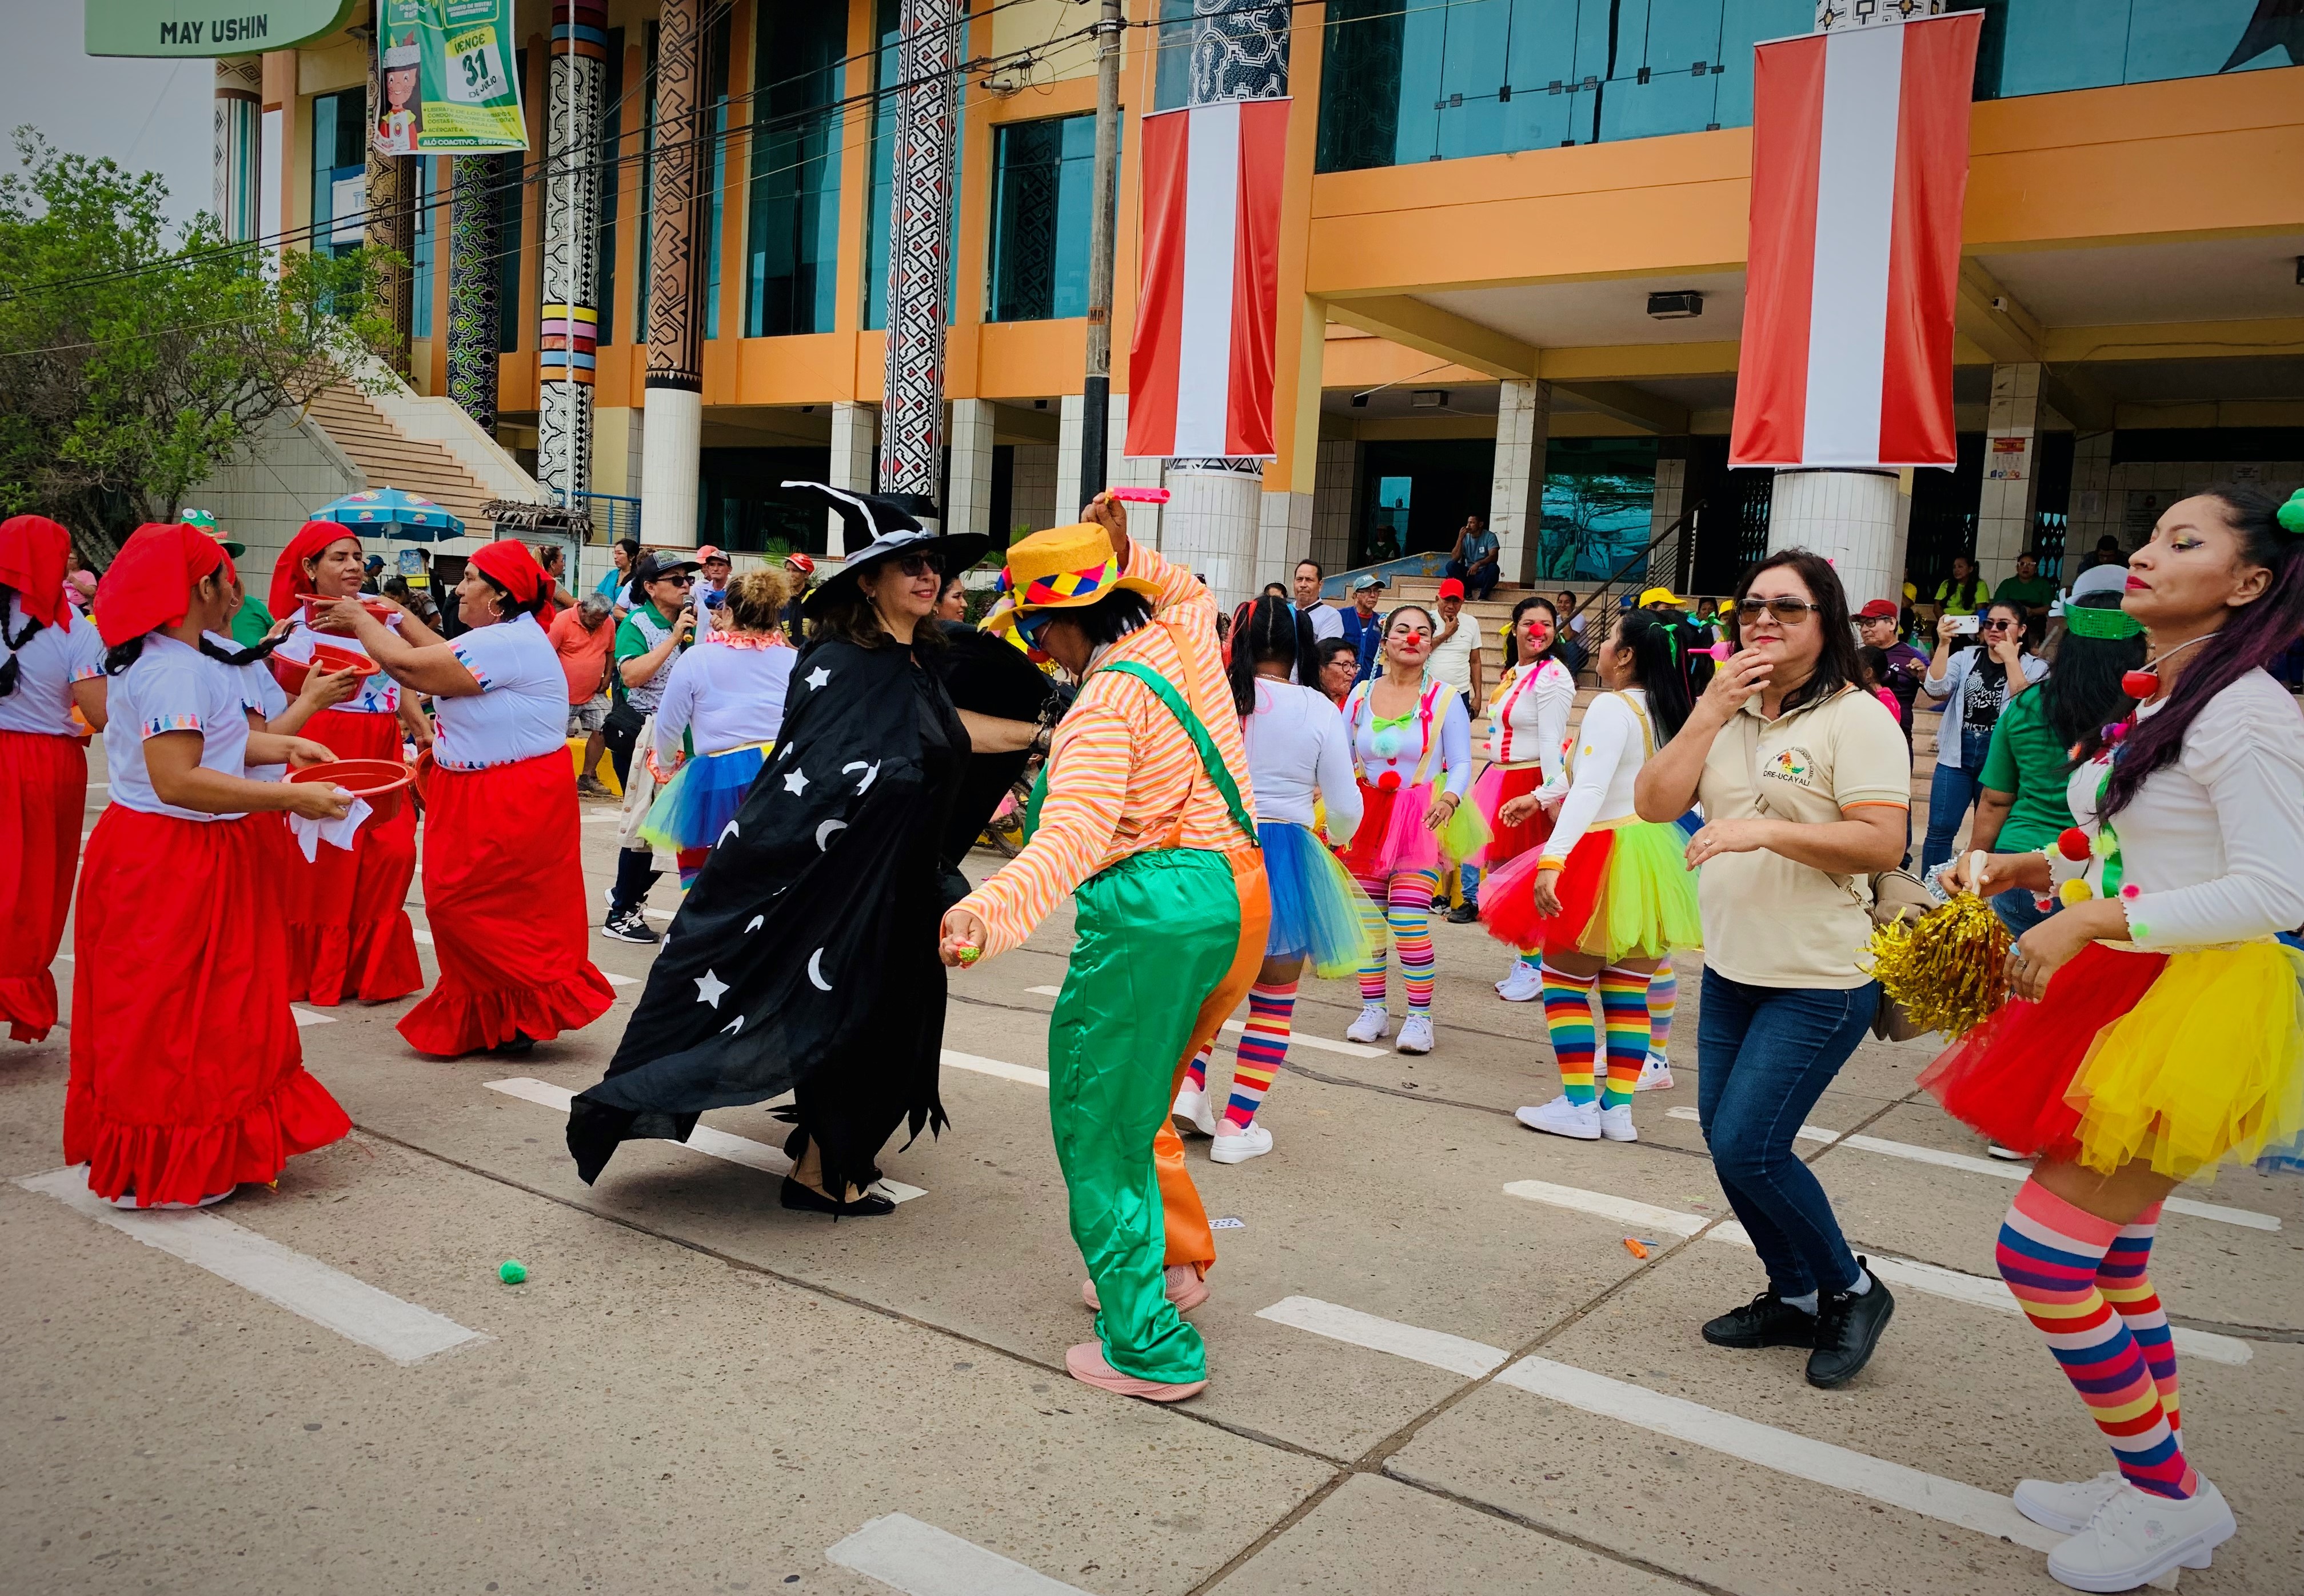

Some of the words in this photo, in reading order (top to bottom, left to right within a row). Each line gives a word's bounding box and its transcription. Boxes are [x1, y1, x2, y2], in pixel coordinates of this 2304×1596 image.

[161, 21, 203, 44] MAY
[212, 14, 267, 43] USHIN
[455, 34, 485, 54] VENCE
[462, 49, 488, 86] 31
[469, 89, 480, 98] DE
[480, 75, 497, 92] JULIO
[423, 138, 437, 146] ALÓ
[1763, 770, 1810, 786] DRE-UCAYALI
